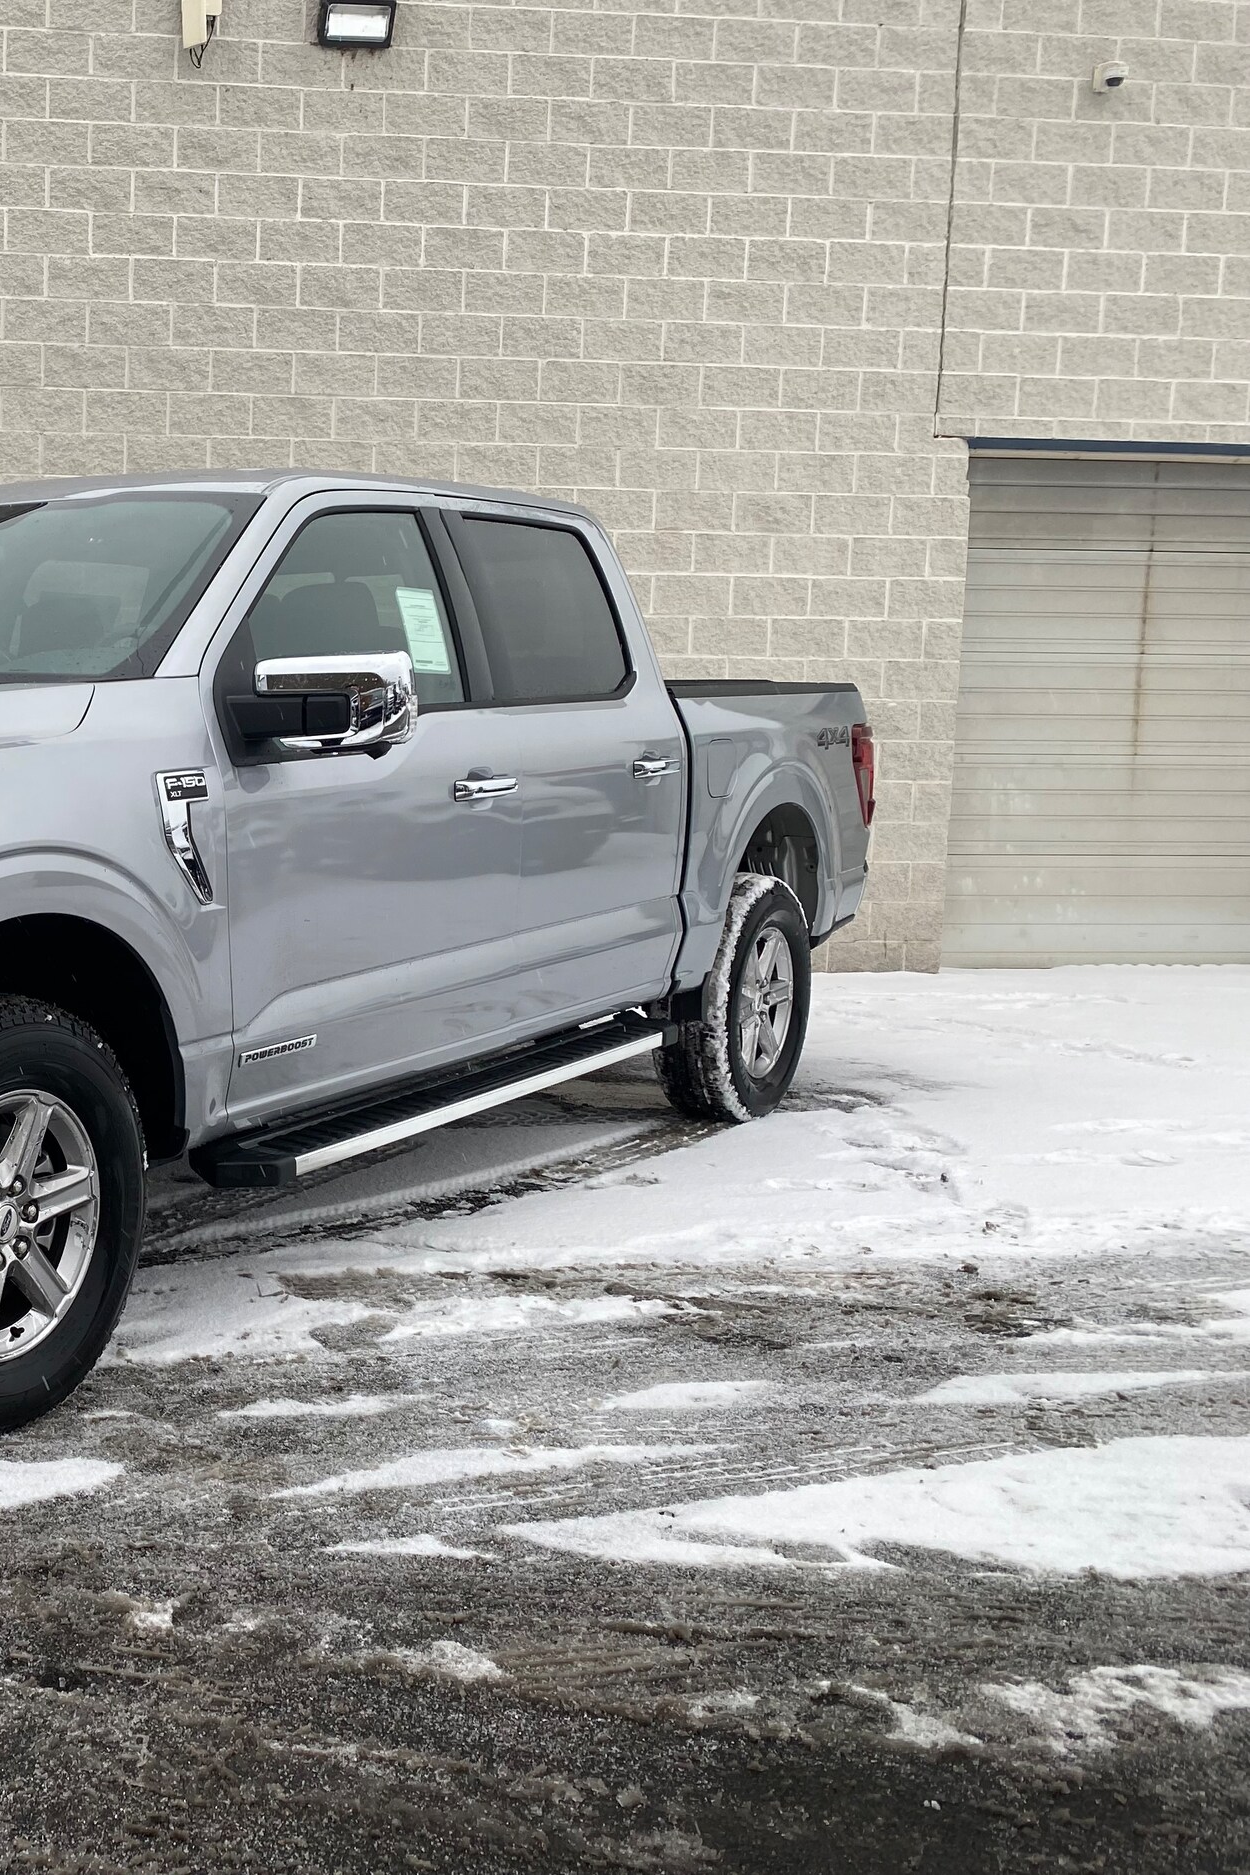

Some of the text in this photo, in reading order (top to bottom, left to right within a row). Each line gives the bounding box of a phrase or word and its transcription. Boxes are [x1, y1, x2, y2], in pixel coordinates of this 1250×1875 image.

[165, 776, 205, 789] F-150
[170, 790, 182, 798] XLT
[244, 1037, 314, 1063] POWERBOOST
